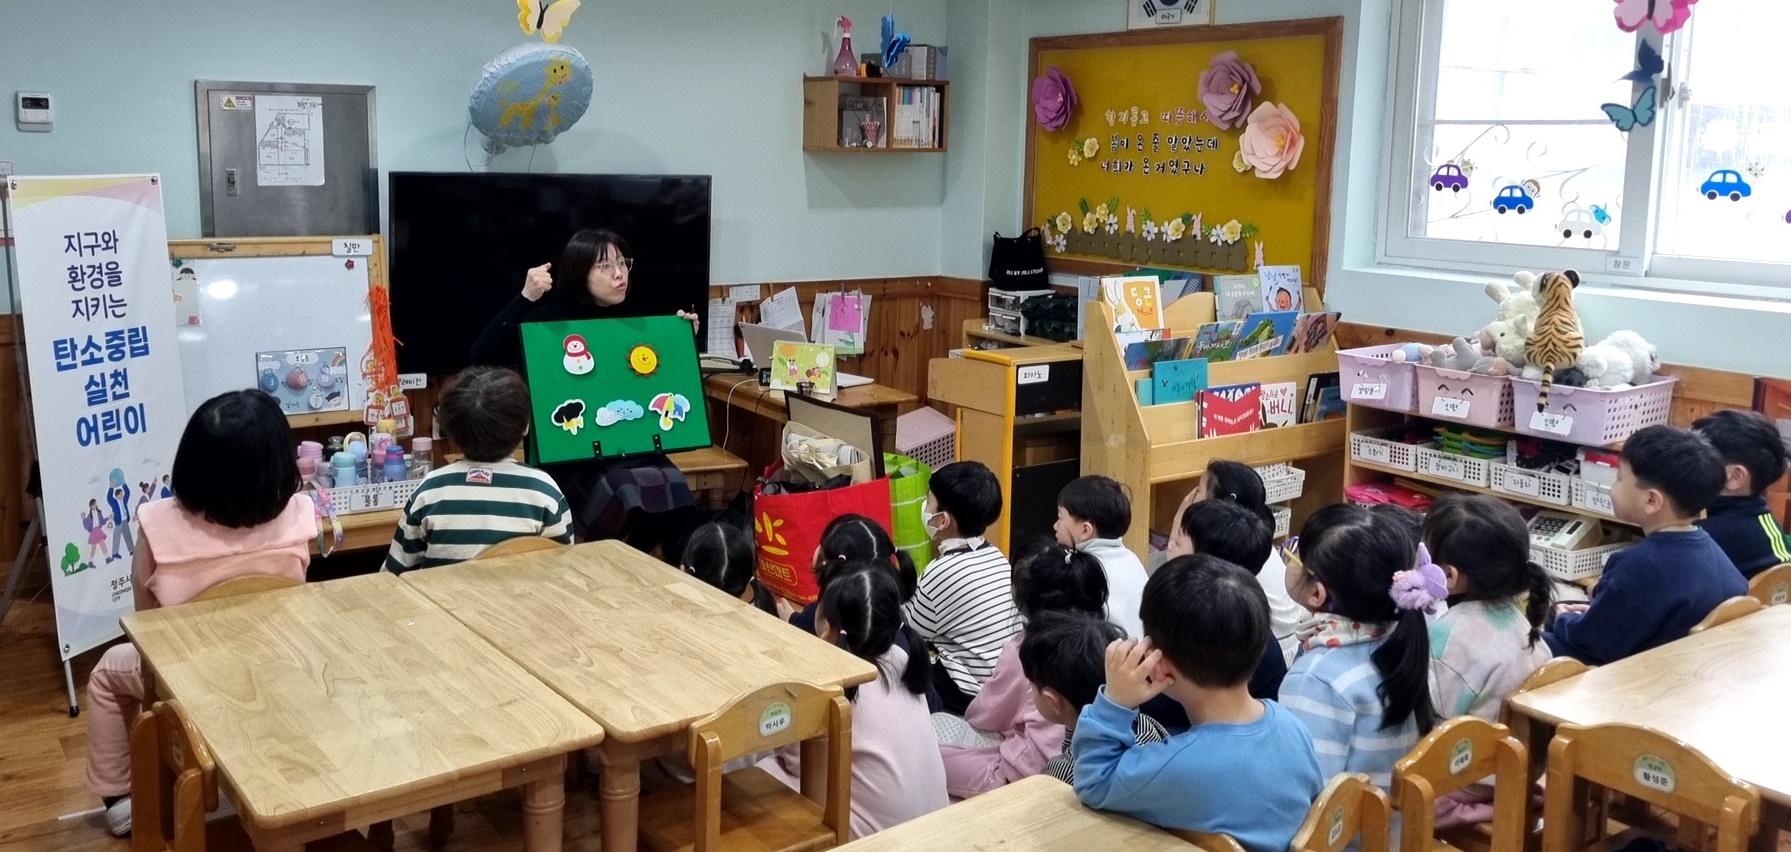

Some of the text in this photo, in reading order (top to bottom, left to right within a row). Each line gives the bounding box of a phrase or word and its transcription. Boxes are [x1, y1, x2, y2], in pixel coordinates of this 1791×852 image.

[1110, 133, 1218, 152] 봄이 온 줄 알았는데
[1101, 157, 1205, 174] 너희가 온 거였구나
[63, 229, 119, 258] 지구와
[343, 242, 361, 253] 칠판
[66, 260, 123, 292] 환경을
[70, 293, 128, 322] 지키는
[52, 325, 150, 373] 탄소중립
[398, 376, 422, 387] 레비전
[1023, 370, 1043, 379] 피아노
[83, 367, 130, 407] 실천
[1270, 399, 1292, 414] 버니
[1445, 402, 1460, 413] 인형
[75, 402, 147, 447] 어린이
[1544, 418, 1560, 428] 인형
[1435, 461, 1459, 473] 장바구니
[363, 494, 379, 507] 물통
